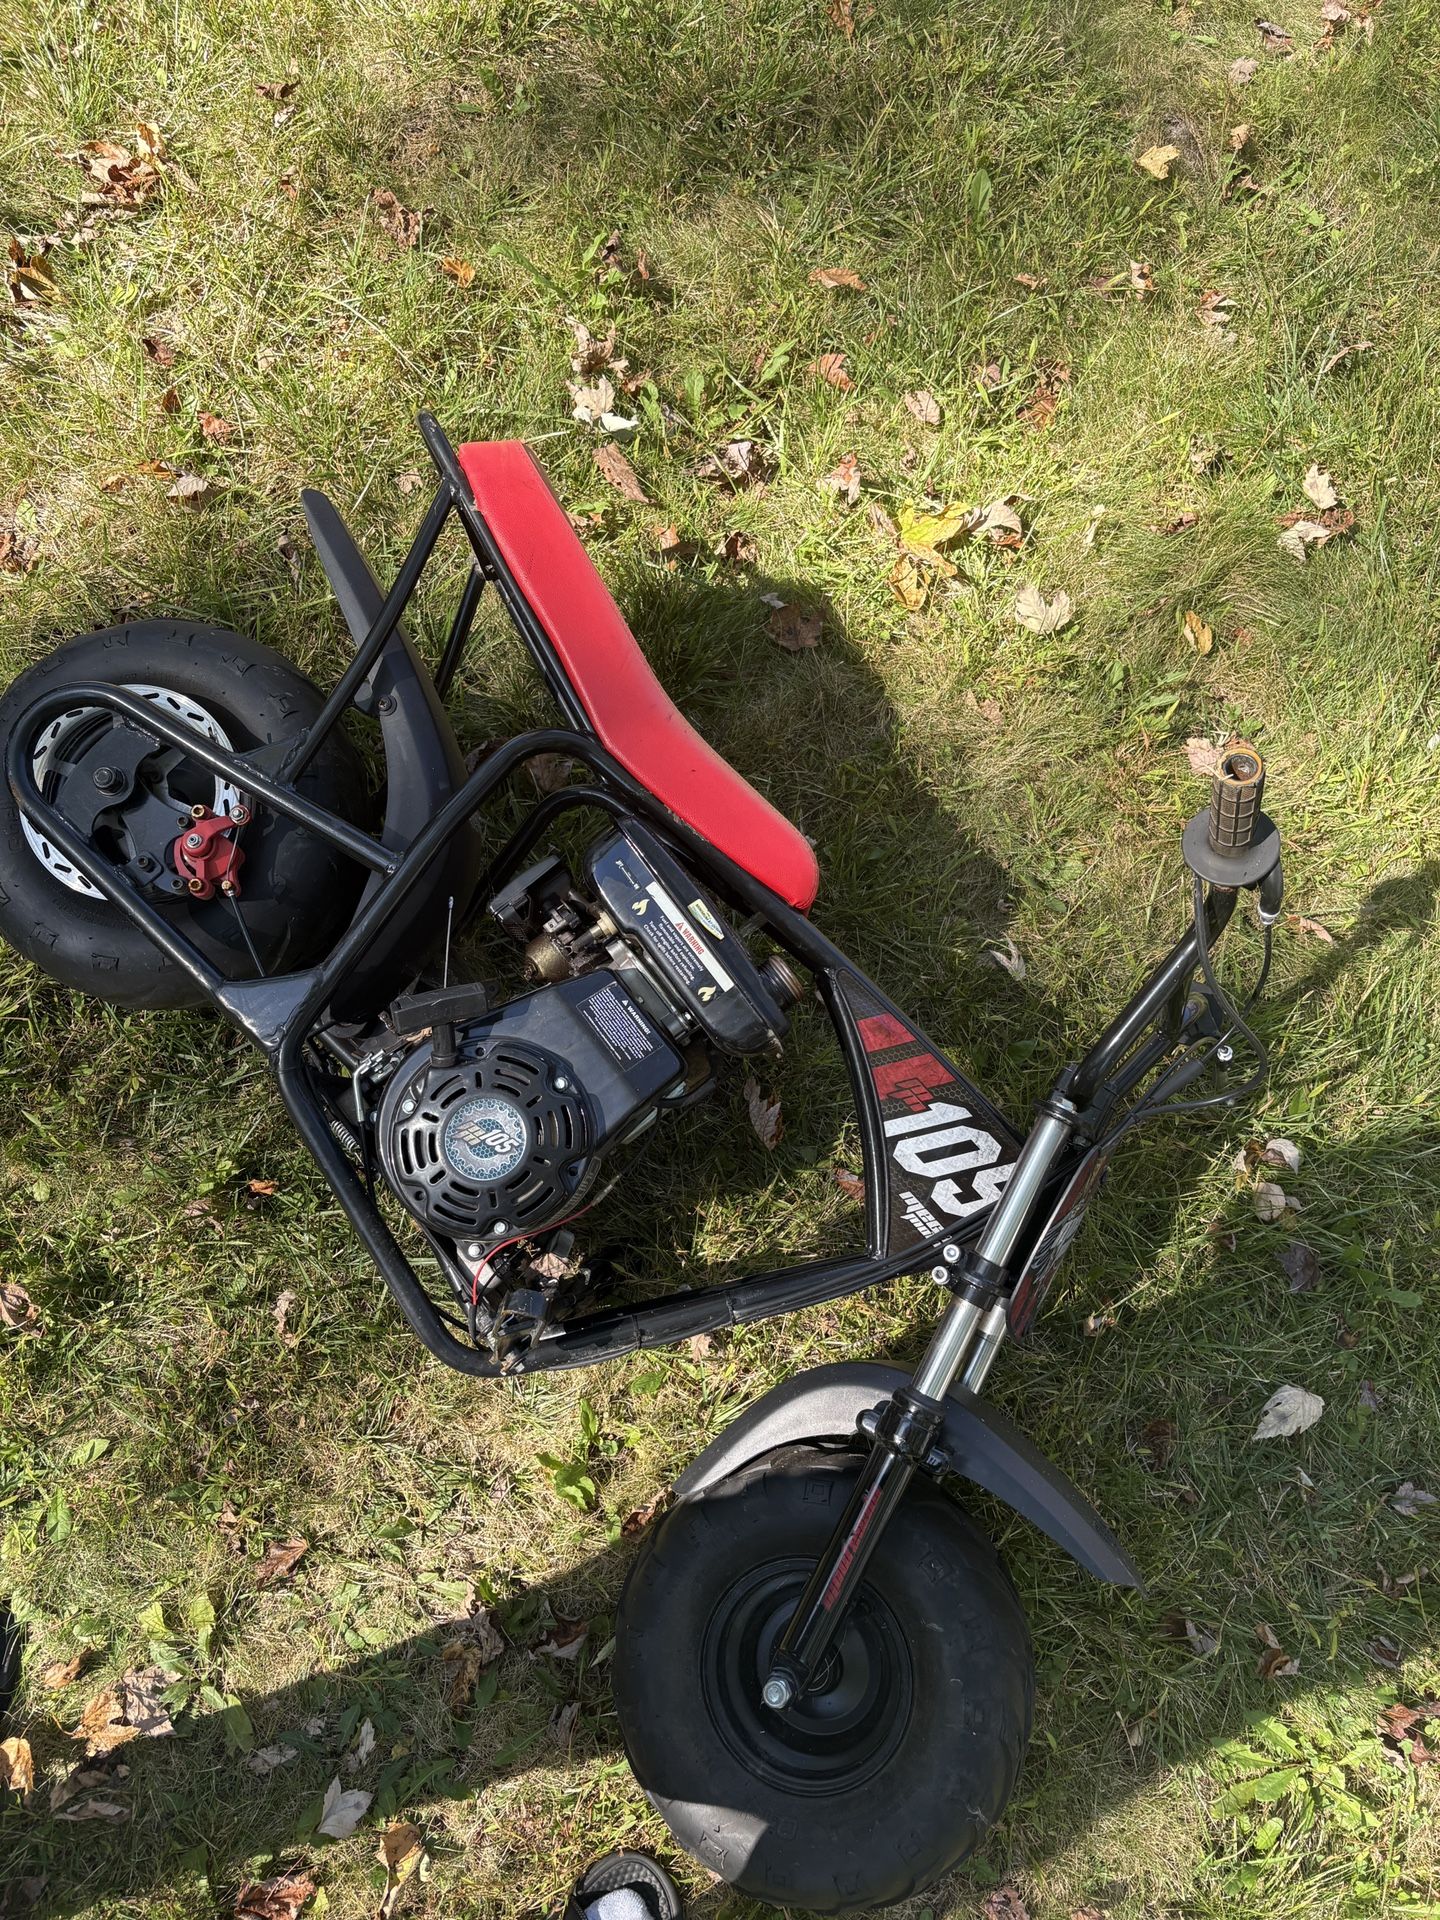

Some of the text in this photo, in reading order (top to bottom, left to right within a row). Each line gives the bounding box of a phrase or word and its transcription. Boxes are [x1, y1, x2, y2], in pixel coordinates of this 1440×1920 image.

[643, 923, 654, 936] Check
[656, 941, 666, 953] spills
[664, 951, 676, 965] before
[648, 920, 658, 931] Turn
[659, 936, 671, 950] engine
[669, 948, 682, 962] before
[659, 914, 668, 924] Fuel
[671, 931, 684, 945] vapors
[686, 950, 704, 971] extremely
[681, 927, 705, 955] WARNING
[626, 1005, 650, 1034] WARNING!
[478, 1129, 521, 1153] 105
[884, 1102, 1018, 1218] 105
